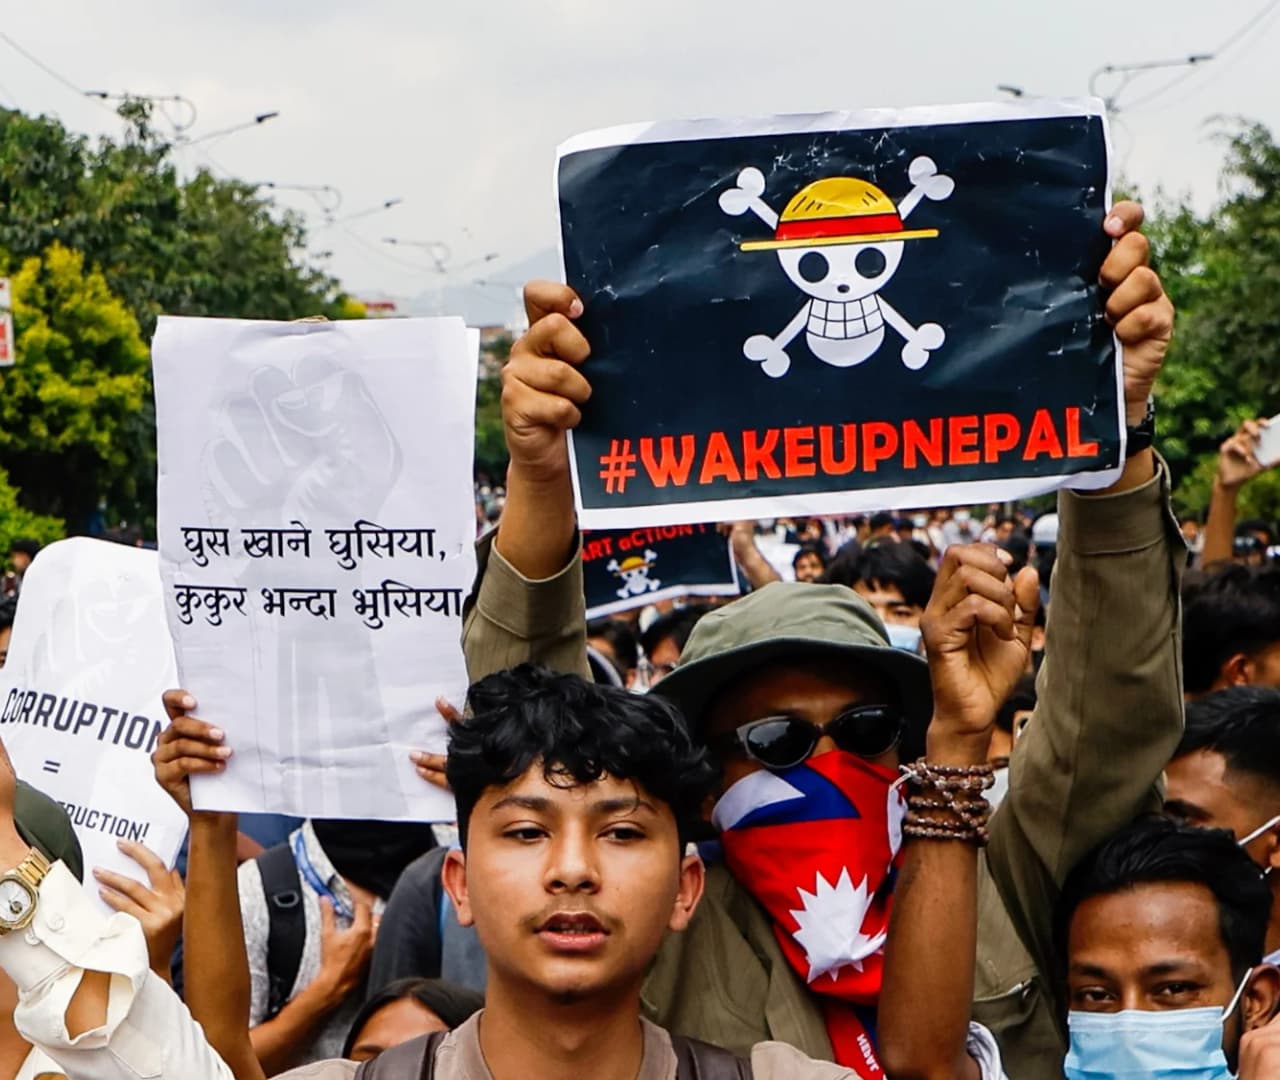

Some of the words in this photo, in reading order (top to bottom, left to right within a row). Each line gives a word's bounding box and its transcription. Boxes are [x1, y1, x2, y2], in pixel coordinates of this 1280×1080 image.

[599, 407, 1099, 494] #WAKEUPNEPAL
[180, 527, 230, 568] घुस
[240, 520, 312, 558] खाने
[324, 519, 446, 571] घुसिया,
[174, 584, 248, 626] कुकुर
[260, 587, 337, 620] भन्दा
[352, 579, 463, 630] भुसिया
